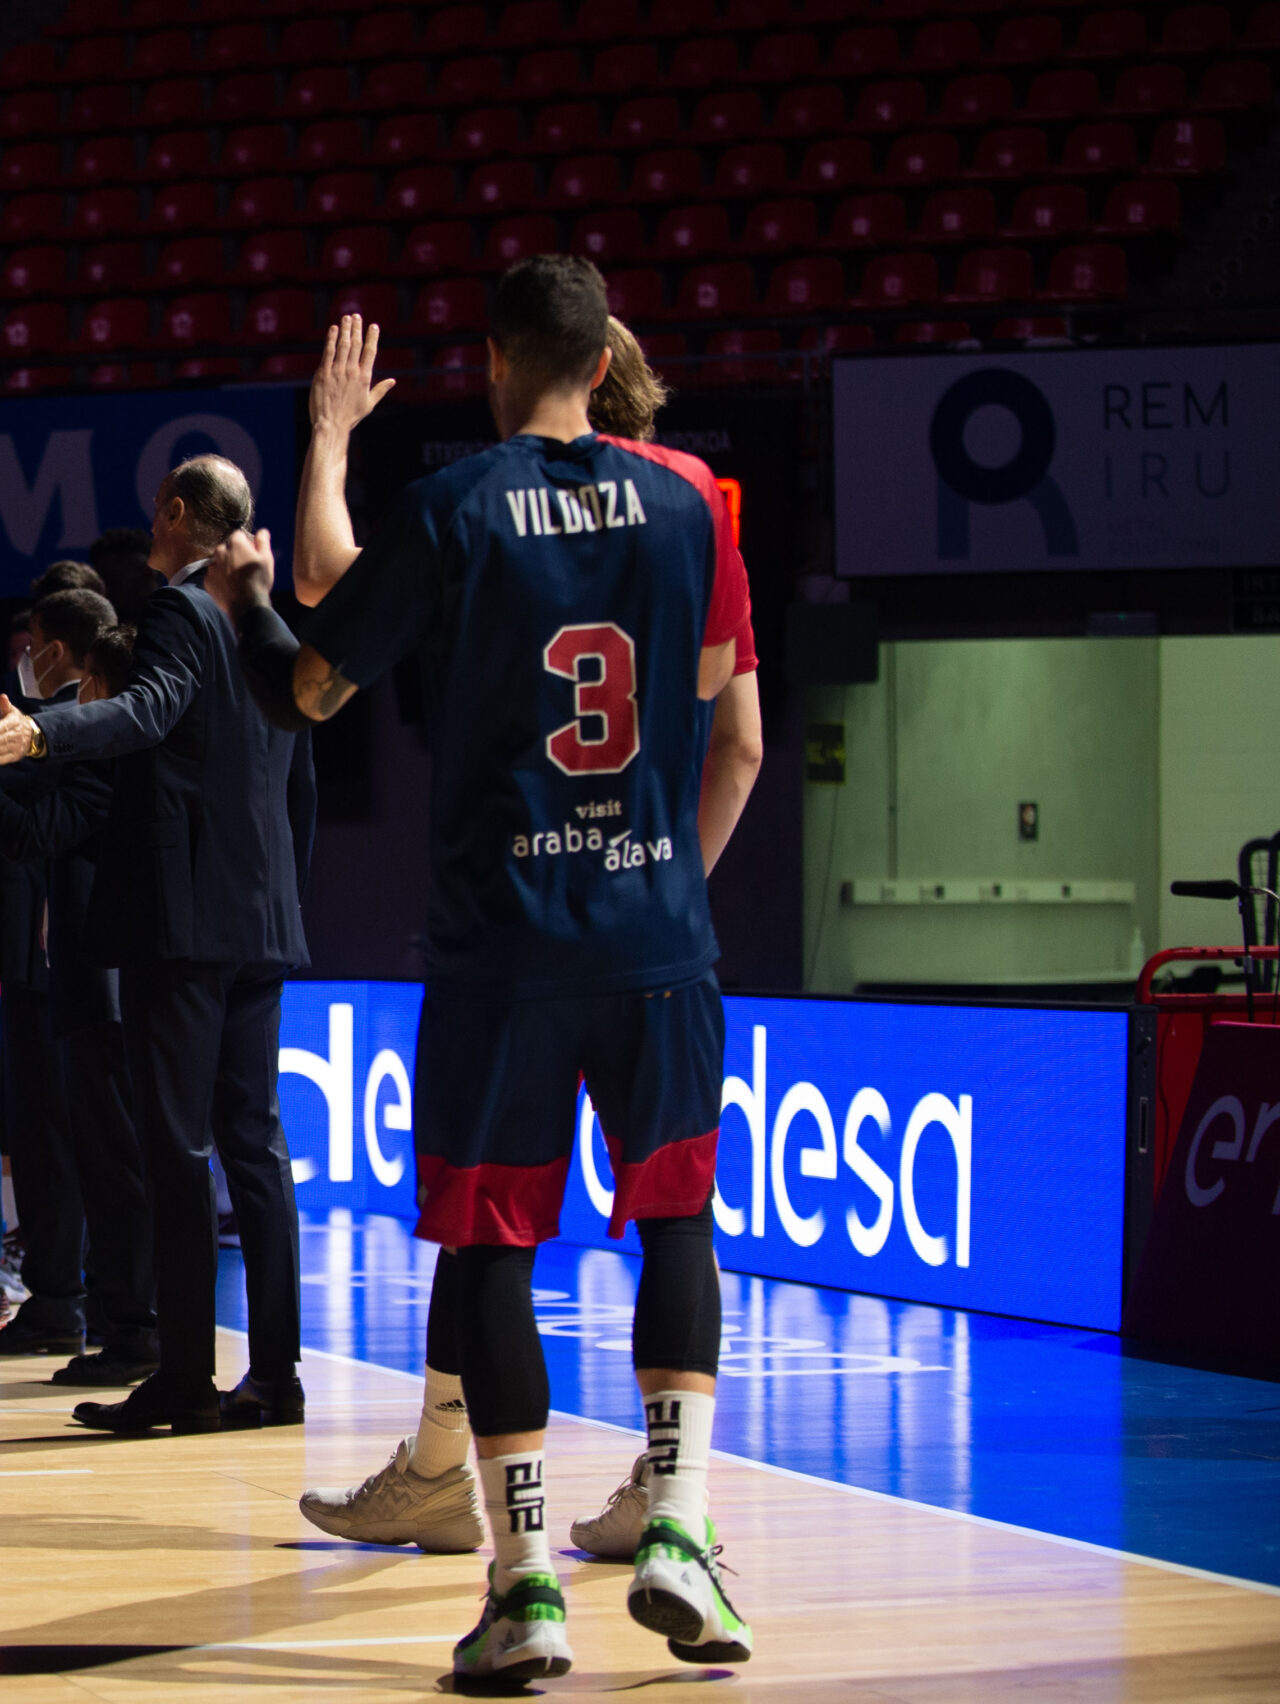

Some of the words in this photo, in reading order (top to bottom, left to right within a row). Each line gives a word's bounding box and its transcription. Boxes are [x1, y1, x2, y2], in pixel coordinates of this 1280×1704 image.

[505, 478, 648, 538] VILDOZA
[542, 621, 641, 777] 3
[575, 799, 623, 820] visit
[511, 822, 604, 858] araba
[577, 1024, 974, 1270] desa
